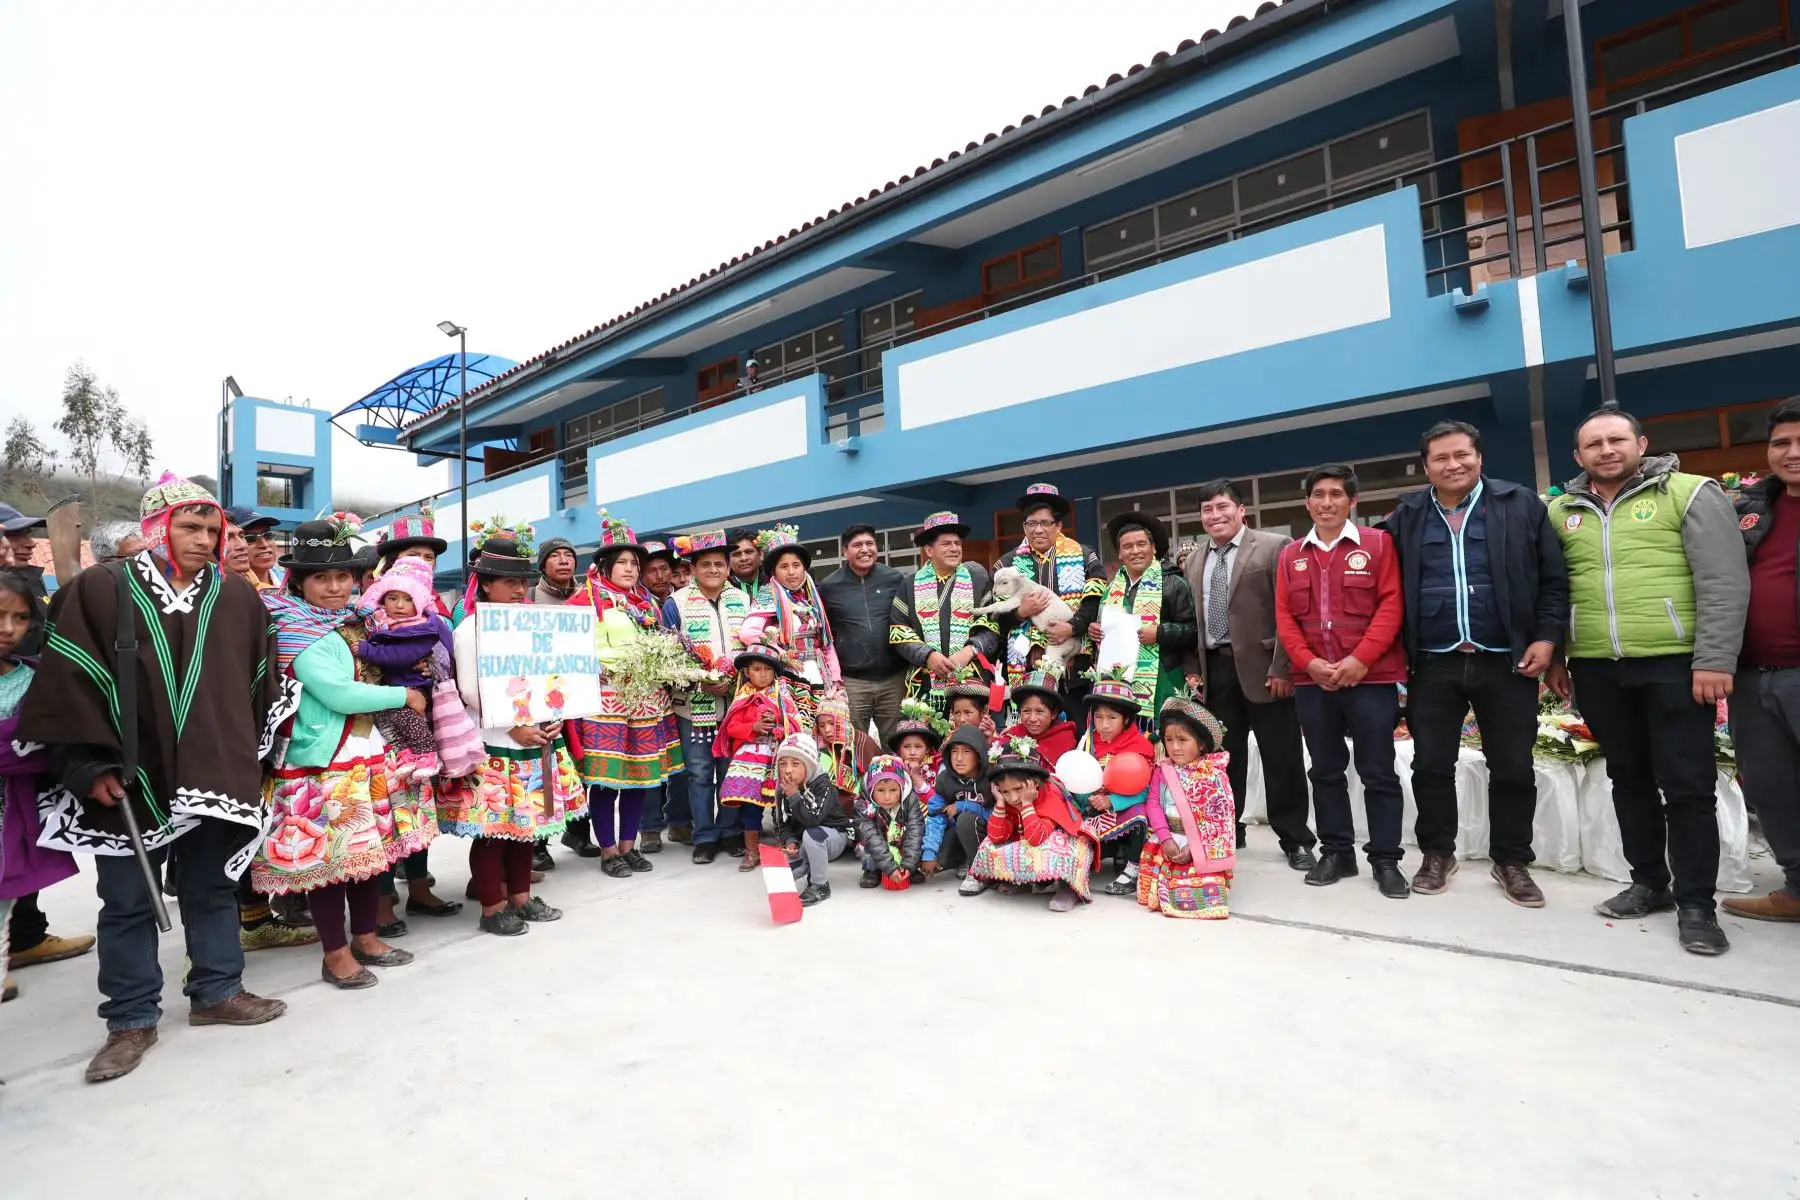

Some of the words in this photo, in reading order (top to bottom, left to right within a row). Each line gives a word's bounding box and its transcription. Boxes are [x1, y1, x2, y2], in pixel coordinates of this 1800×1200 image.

[481, 609, 510, 632] IEI
[532, 631, 553, 653] DE
[478, 653, 600, 677] HUAYNACANCHA
[955, 791, 985, 803] FILA
